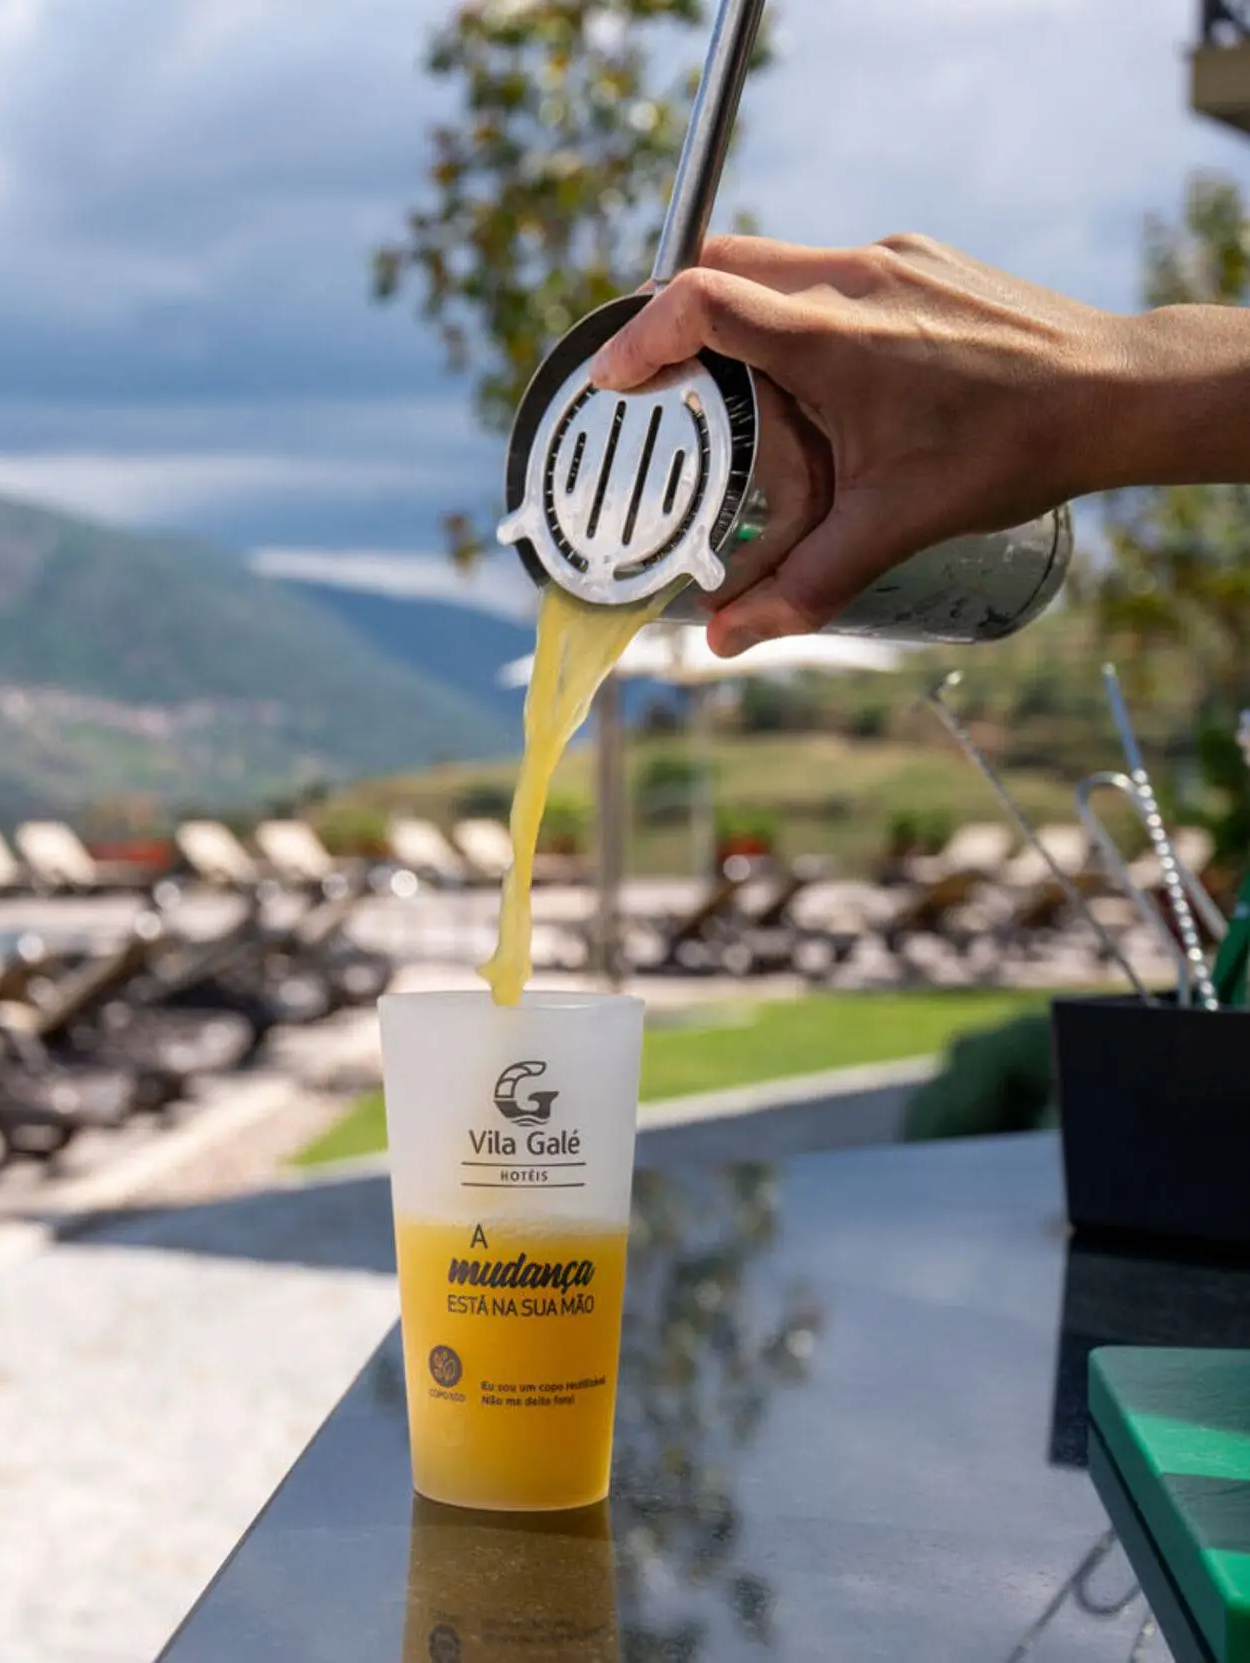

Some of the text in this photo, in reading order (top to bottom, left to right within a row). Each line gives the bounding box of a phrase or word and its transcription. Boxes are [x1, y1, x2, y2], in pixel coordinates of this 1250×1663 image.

[468, 1130, 581, 1155] Vila Galé
[500, 1169, 549, 1183] HOTÉIS
[470, 1223, 488, 1249] A
[448, 1252, 595, 1293] mudança
[447, 1293, 594, 1317] ESTÁ NA SUA MÃO
[481, 1381, 494, 1392] Eu
[520, 1383, 536, 1392] um
